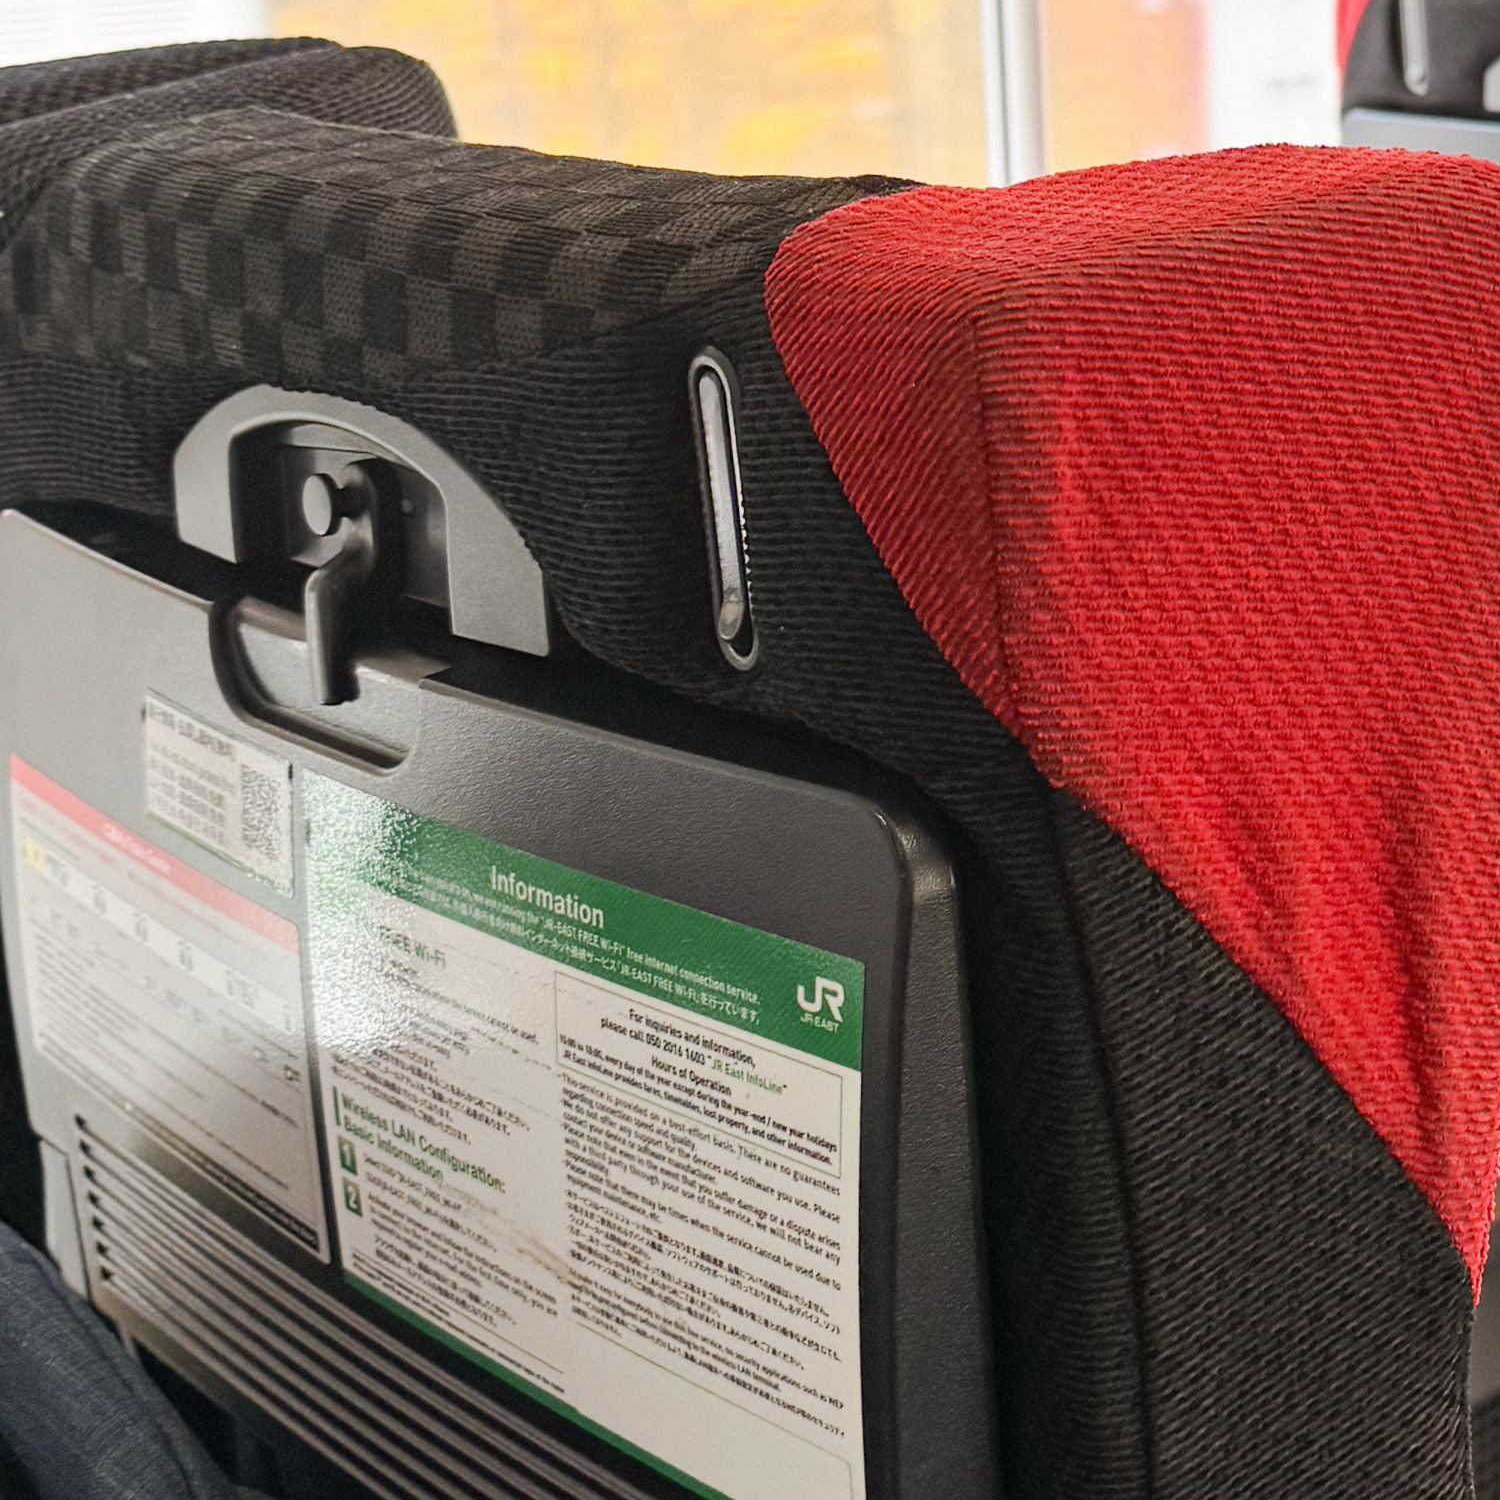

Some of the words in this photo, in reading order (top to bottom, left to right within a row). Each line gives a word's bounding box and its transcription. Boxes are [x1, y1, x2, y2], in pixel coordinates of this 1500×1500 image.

[490, 863, 603, 930] Information
[577, 928, 599, 947] FREE
[679, 969, 725, 994] connection
[726, 986, 760, 1007] service.
[796, 976, 845, 1023] JR
[600, 1015, 627, 1035] please
[629, 1027, 644, 1041] call
[725, 1061, 743, 1080] East
[629, 1008, 643, 1024] For
[645, 1014, 682, 1039] inquiries
[684, 1032, 699, 1046] and
[702, 1035, 755, 1070] information,
[623, 1058, 635, 1073] day
[637, 1065, 643, 1075] of
[644, 1067, 655, 1079] the
[657, 1074, 671, 1086] year
[673, 1080, 694, 1096] except
[697, 1087, 719, 1107] during
[721, 1097, 732, 1110] the
[772, 1120, 786, 1132] new
[789, 1127, 803, 1139] year
[652, 1054, 676, 1075] Hours
[679, 1066, 686, 1079] of
[689, 1069, 730, 1096] Operation
[341, 1093, 388, 1131] Wireless
[391, 1120, 415, 1146] LAN
[752, 1127, 764, 1138] and
[766, 1131, 785, 1147] other
[342, 1143, 351, 1167] 1
[343, 1115, 374, 1145] Basic
[377, 1134, 443, 1183] Information
[738, 1146, 761, 1164] There
[764, 1159, 777, 1171] are
[780, 1166, 790, 1176] no
[793, 1171, 840, 1197] guarantees
[347, 1185, 357, 1209] 2
[724, 1168, 737, 1180] and
[740, 1175, 774, 1196] software
[777, 1191, 792, 1203] you
[813, 1204, 840, 1224] Please
[708, 1198, 720, 1211] the
[756, 1222, 766, 1232] we
[770, 1227, 784, 1240] will
[787, 1235, 800, 1247] not
[804, 1241, 822, 1257] bear
[825, 1252, 840, 1267] any
[712, 1226, 724, 1239] the
[726, 1234, 752, 1252] service
[783, 1258, 792, 1270] be
[795, 1265, 813, 1279] used
[816, 1272, 829, 1287] due
[833, 1280, 840, 1292] to
[769, 1214, 778, 1224] or
[817, 1235, 840, 1251] arises
